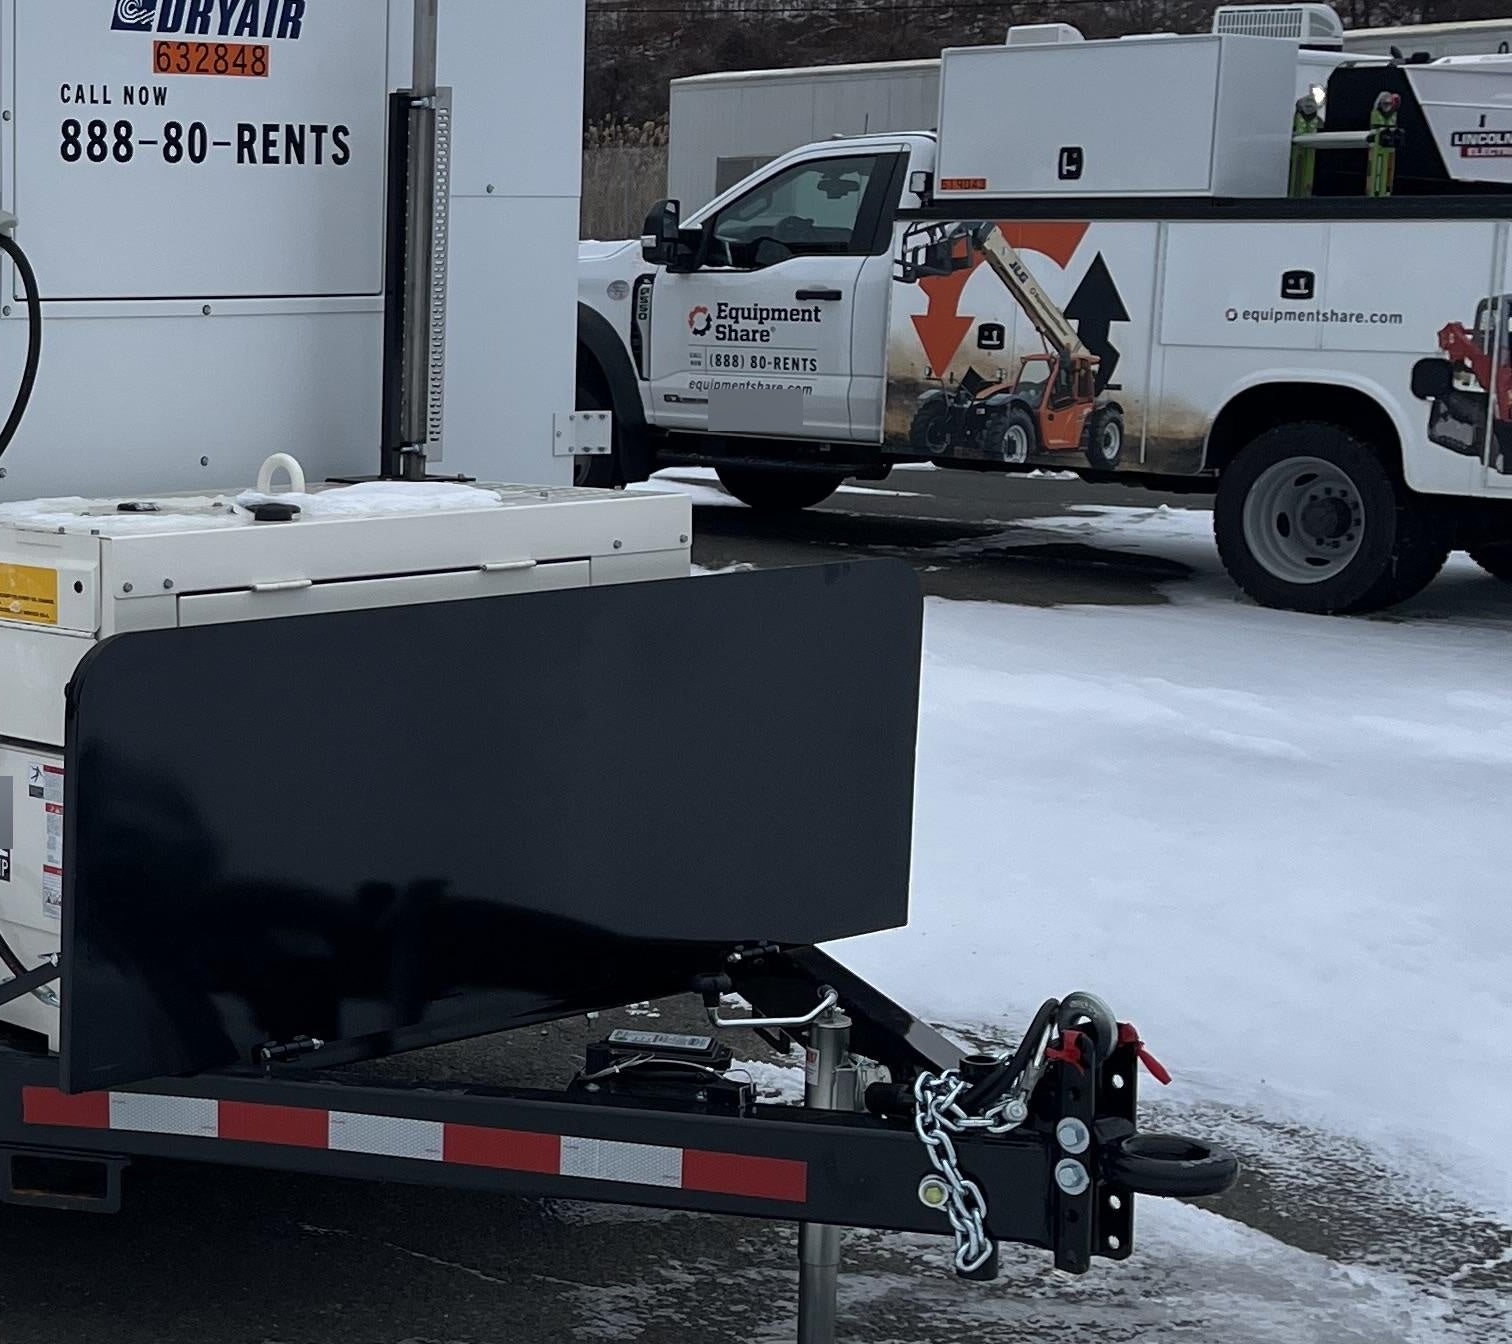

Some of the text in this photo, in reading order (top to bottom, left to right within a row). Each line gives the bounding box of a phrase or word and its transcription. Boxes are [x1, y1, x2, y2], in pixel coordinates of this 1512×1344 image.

[156, 41, 267, 76] 632848
[60, 83, 168, 106] CALL NOW
[60, 118, 351, 166] 888-80-RENTS
[716, 302, 822, 324] Equipment
[1242, 308, 1403, 324] equipmentshare.com
[715, 324, 771, 342] Share
[709, 353, 818, 372] (888) 80-RENTS
